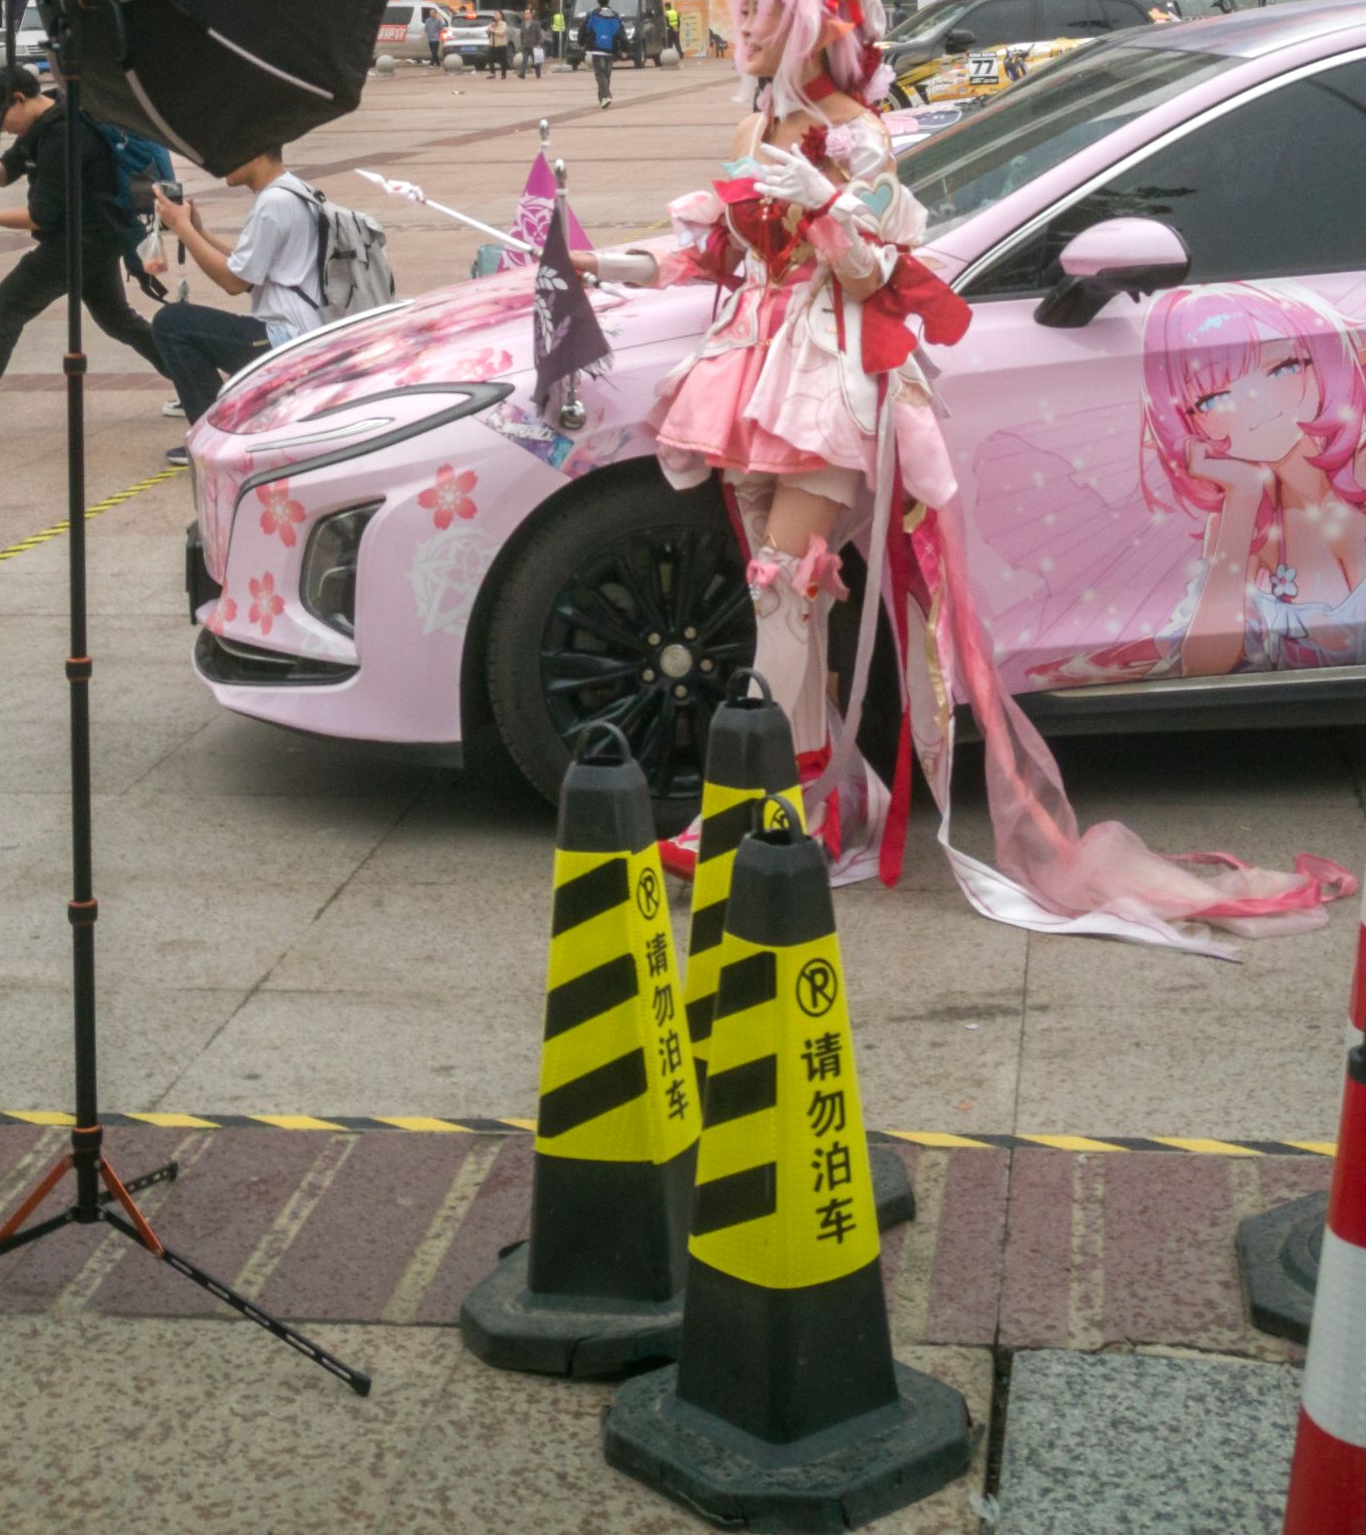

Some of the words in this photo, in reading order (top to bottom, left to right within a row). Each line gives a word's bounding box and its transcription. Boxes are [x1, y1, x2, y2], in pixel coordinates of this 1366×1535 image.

[971, 59, 995, 76] 77
[644, 931, 691, 1122] 请勿泊车
[800, 1030, 858, 1246] 请勿泊车
